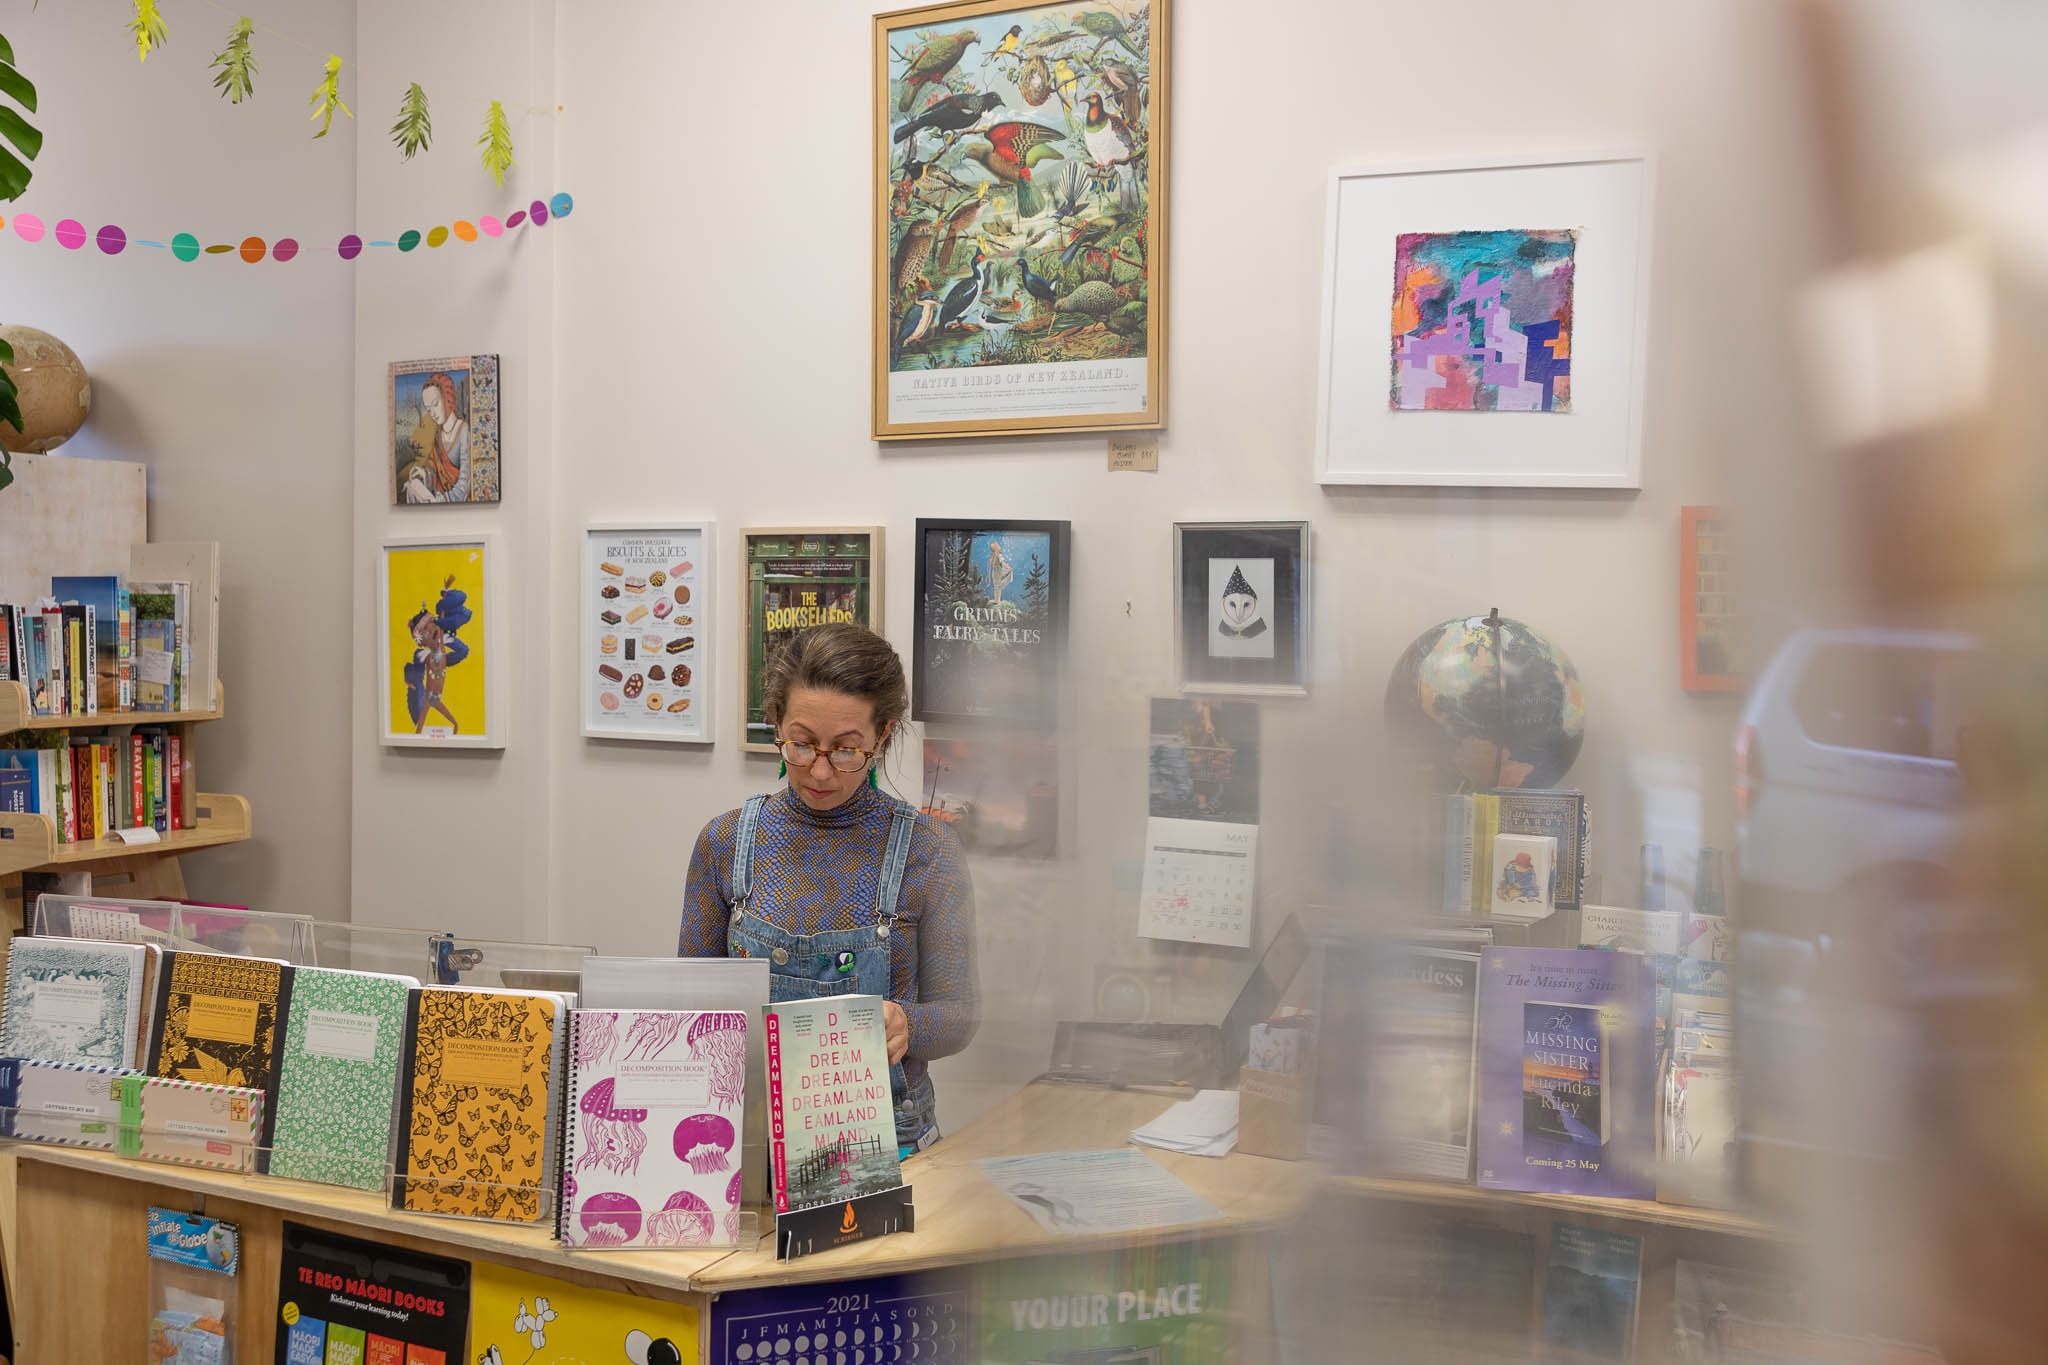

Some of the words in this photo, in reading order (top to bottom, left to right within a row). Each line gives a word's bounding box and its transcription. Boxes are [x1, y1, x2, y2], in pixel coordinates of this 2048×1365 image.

[912, 377, 958, 390] NATIVE
[961, 375, 1001, 387] BIRDS
[607, 546, 646, 558] BISCUITS
[658, 546, 687, 557] SLICES
[801, 591, 817, 606] THE
[933, 624, 981, 641] FAIRY
[991, 627, 1041, 643] TALES
[1513, 818, 1562, 826] TAROT
[1506, 974, 1531, 988] The
[1534, 977, 1583, 993] Missing
[828, 1012, 838, 1027] D
[448, 1042, 501, 1053] DECOMPOSITION
[819, 1030, 849, 1048] DRE
[1525, 1030, 1599, 1053] MISSING
[621, 1065, 683, 1073] DECOMPOSITION
[810, 1049, 862, 1069] DREAM
[1533, 1050, 1590, 1071] SISTER
[769, 1019, 783, 1134] DREAMLAND
[801, 1067, 874, 1090] DREAMLA
[1530, 1074, 1592, 1097] Lucinda
[792, 1085, 886, 1112] DREAMLAND
[1540, 1094, 1581, 1117] Riley
[804, 1106, 878, 1131] EAMLAND
[1525, 1156, 1563, 1170] Coming
[1566, 1158, 1577, 1169] 25
[1579, 1159, 1601, 1172] May
[839, 1169, 850, 1185] D
[298, 1267, 313, 1285] TE
[315, 1272, 343, 1291] REO
[346, 1279, 392, 1304] MĀORI
[394, 1292, 445, 1318] BOOKS
[1117, 1282, 1202, 1323] PLACE
[330, 1293, 356, 1307] Kickstart
[355, 1300, 368, 1311] your
[368, 1303, 391, 1319] learning
[391, 1309, 409, 1323] today!
[826, 1294, 870, 1315] 2021
